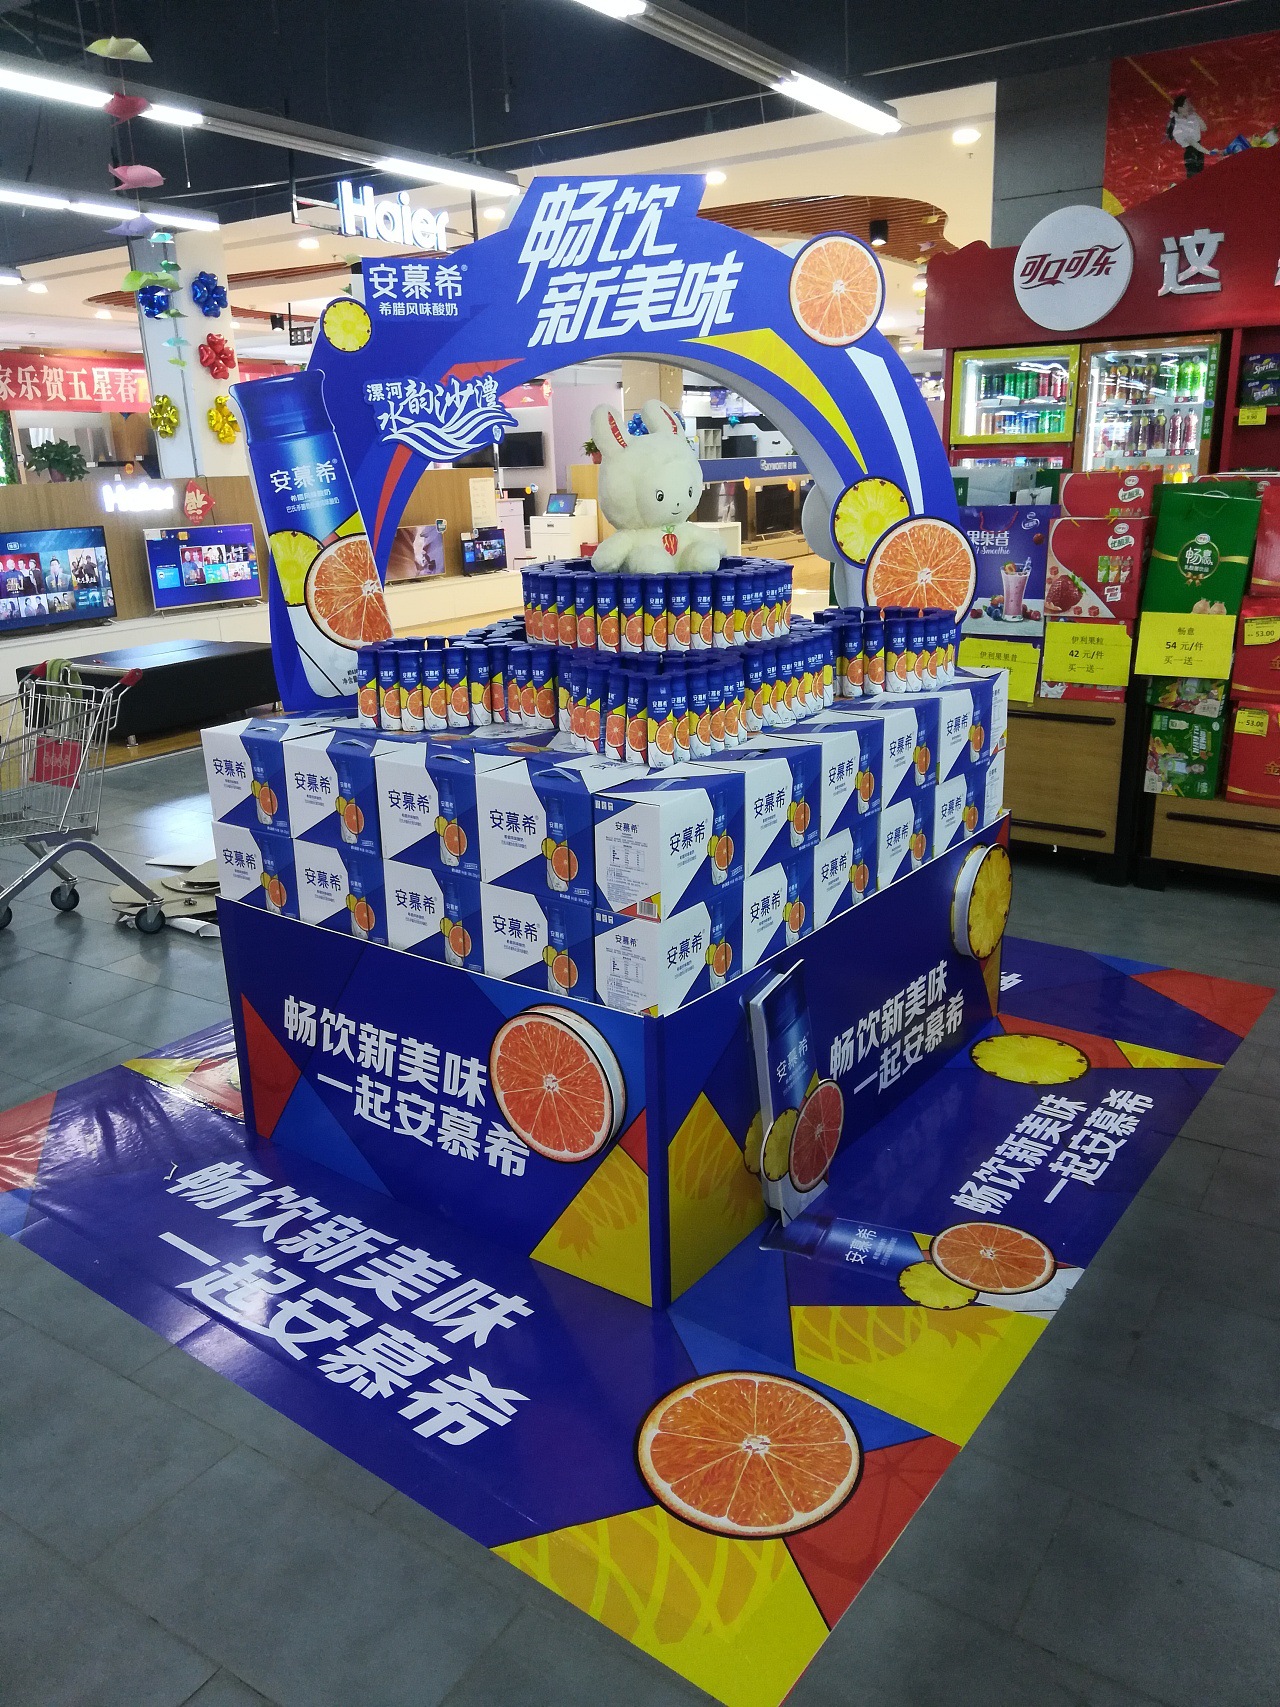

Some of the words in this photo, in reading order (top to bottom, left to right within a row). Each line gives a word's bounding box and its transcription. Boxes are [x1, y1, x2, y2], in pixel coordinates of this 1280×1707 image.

[337, 180, 449, 250] Haier
[517, 179, 681, 304] 畅饮
[1019, 243, 1124, 289] 可口可乐
[1157, 229, 1224, 296] 这
[369, 263, 463, 300] 安慕希
[527, 249, 744, 347] 新美味
[378, 302, 459, 317] 希腊风味酸奶
[366, 382, 402, 402] 漯河
[270, 460, 336, 493] 安慕希
[967, 530, 1009, 546] 果果昔
[1068, 650, 1080, 658] 42
[1165, 642, 1177, 650] 54
[946, 713, 968, 736] 安慕希
[889, 733, 913, 759] 安慕希
[212, 758, 247, 780] 安慕希
[294, 771, 331, 795] 安慕希
[828, 757, 854, 787] 安慕希
[388, 789, 431, 814] 安慕希
[754, 786, 786, 819] 安慕希
[941, 796, 962, 819] 安慕希
[489, 809, 536, 835] 安慕希
[670, 820, 706, 856] 安慕希
[886, 822, 909, 850] 安慕希
[223, 848, 257, 870] 安慕希
[820, 853, 848, 883] 安慕希
[305, 867, 341, 892] 安慕希
[395, 889, 436, 914] 安慕希
[750, 889, 781, 924] 安慕希
[493, 915, 538, 942] 安慕希
[666, 931, 703, 969] 安慕希
[830, 960, 948, 1078] 畅饮新美味
[284, 995, 487, 1107] 畅饮新美味
[854, 989, 964, 1095] 一起安慕希
[776, 1037, 809, 1083] 安慕希
[318, 1073, 530, 1177] 一起安慕希
[950, 1094, 1087, 1215] 畅饮新美味
[1044, 1089, 1154, 1204] 一起安慕希
[165, 1161, 535, 1349] 畅饮新美味
[845, 1228, 877, 1265] 安慕希
[158, 1231, 531, 1446] 一起安慕希
